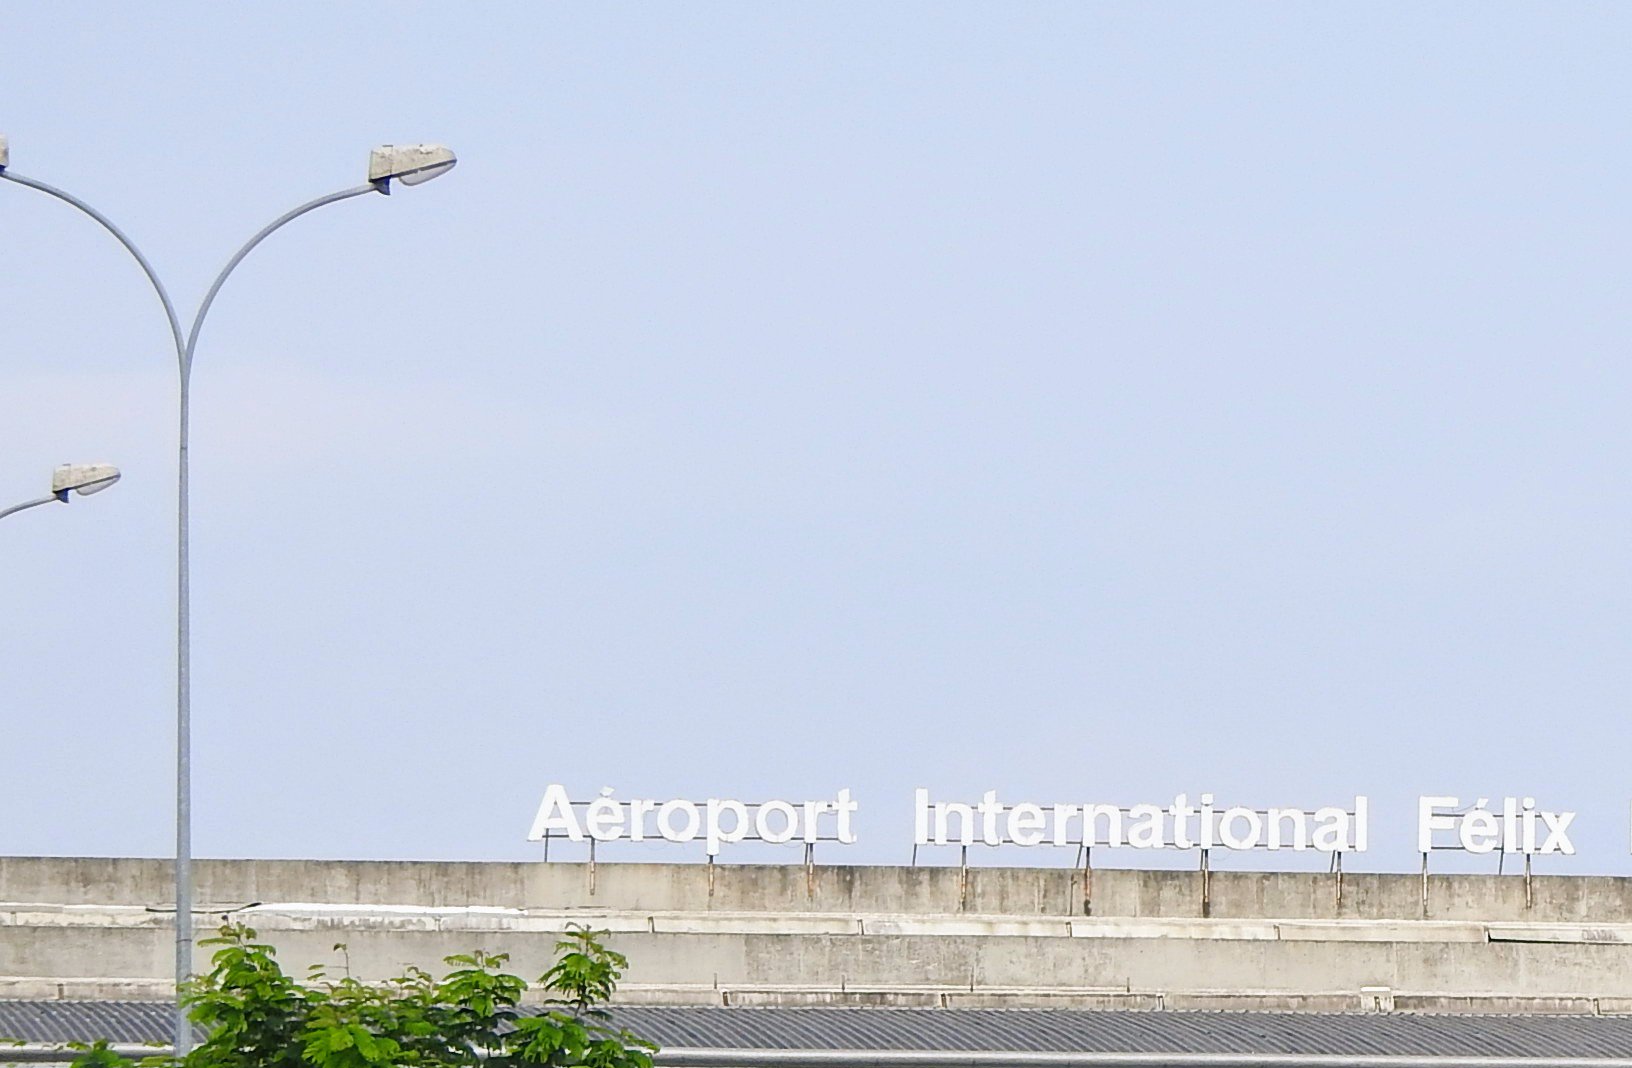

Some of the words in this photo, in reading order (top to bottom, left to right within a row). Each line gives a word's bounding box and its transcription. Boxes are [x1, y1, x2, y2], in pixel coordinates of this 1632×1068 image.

[527, 784, 858, 856] Aéroport
[915, 788, 1368, 853] International
[1418, 796, 1576, 855] Félix
